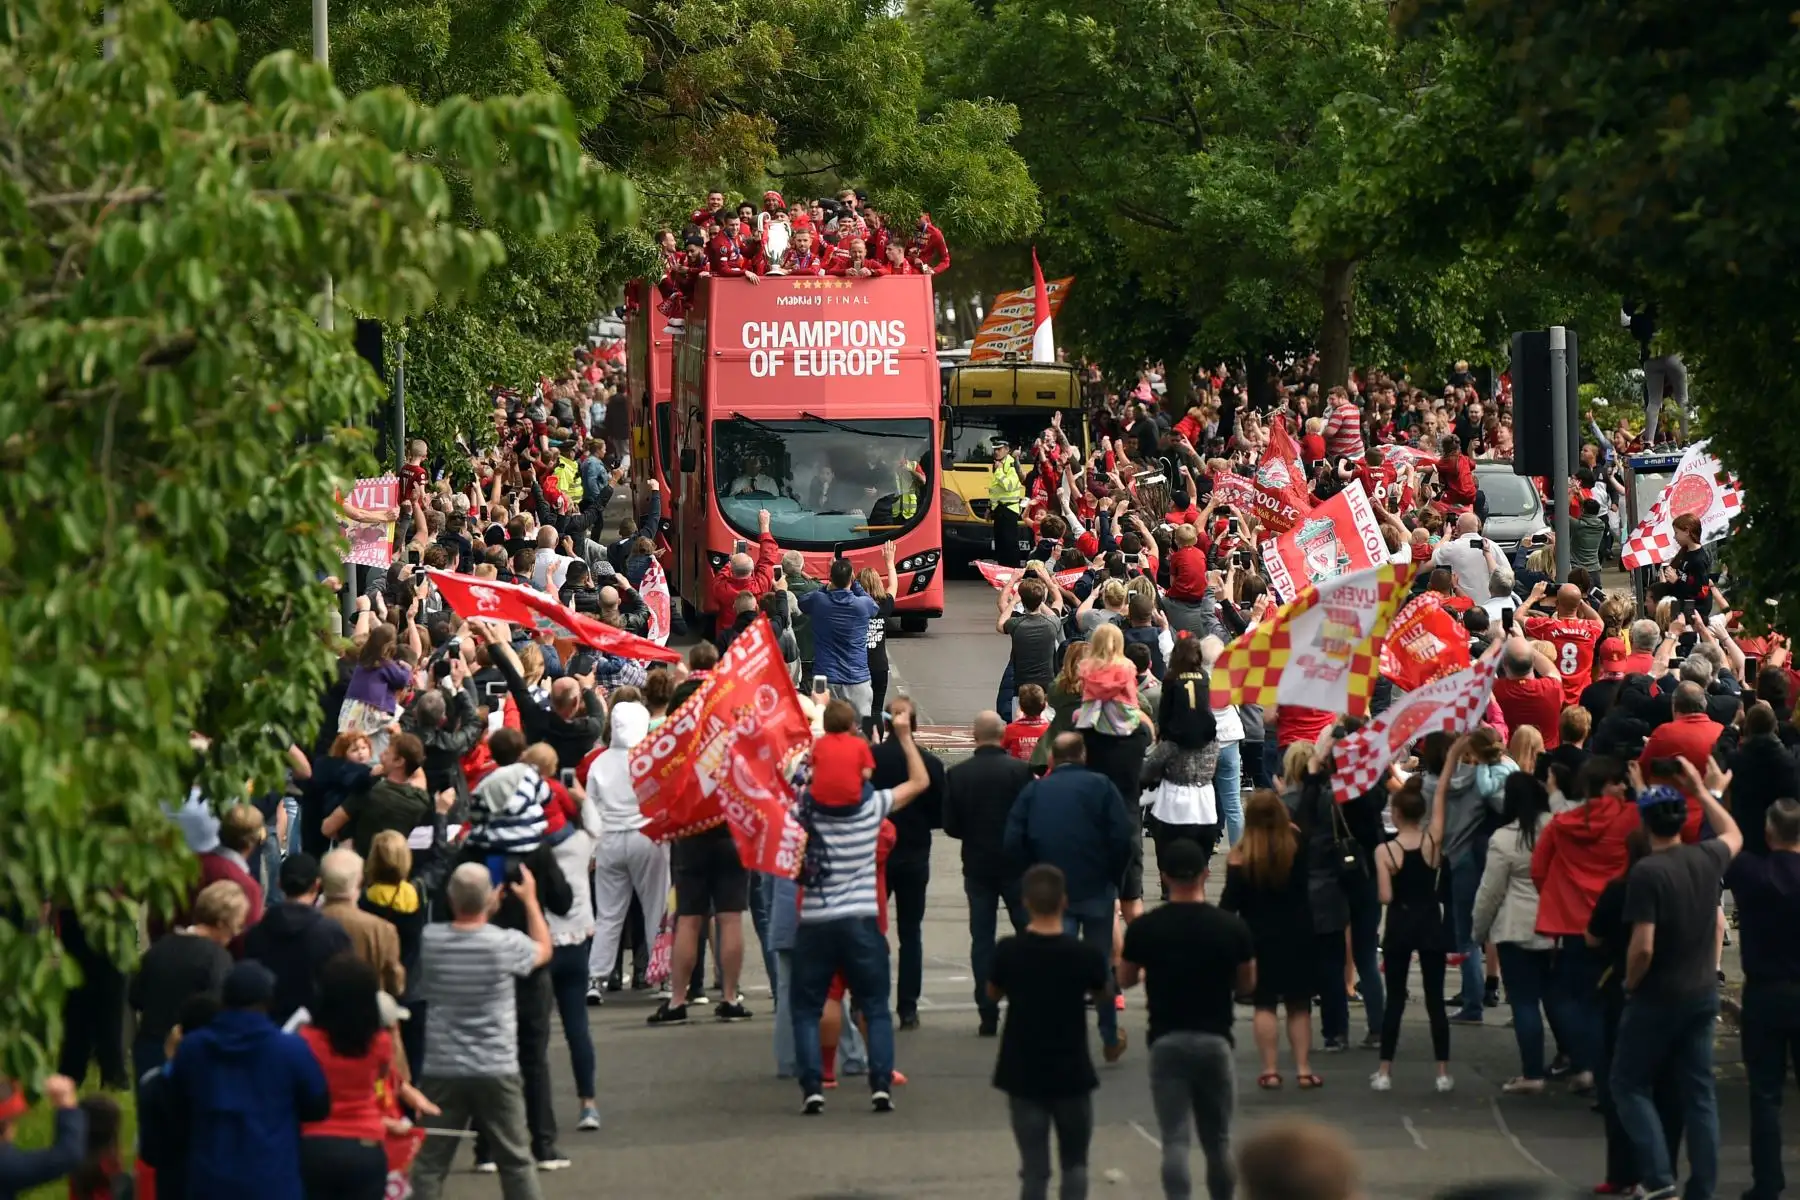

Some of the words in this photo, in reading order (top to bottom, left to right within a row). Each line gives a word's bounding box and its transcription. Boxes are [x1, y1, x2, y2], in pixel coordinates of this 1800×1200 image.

[827, 296, 869, 305] FINAL
[742, 320, 906, 349] CHAMPIONS
[750, 350, 784, 377] OF
[794, 349, 899, 377] EUROPE
[1644, 456, 1666, 465] e-mail
[1374, 480, 1386, 499] 6
[1253, 488, 1280, 512] POOL
[1281, 505, 1300, 520] FC
[1256, 506, 1270, 520] Walk
[1560, 642, 1578, 675] 8
[1184, 680, 1196, 709] 1
